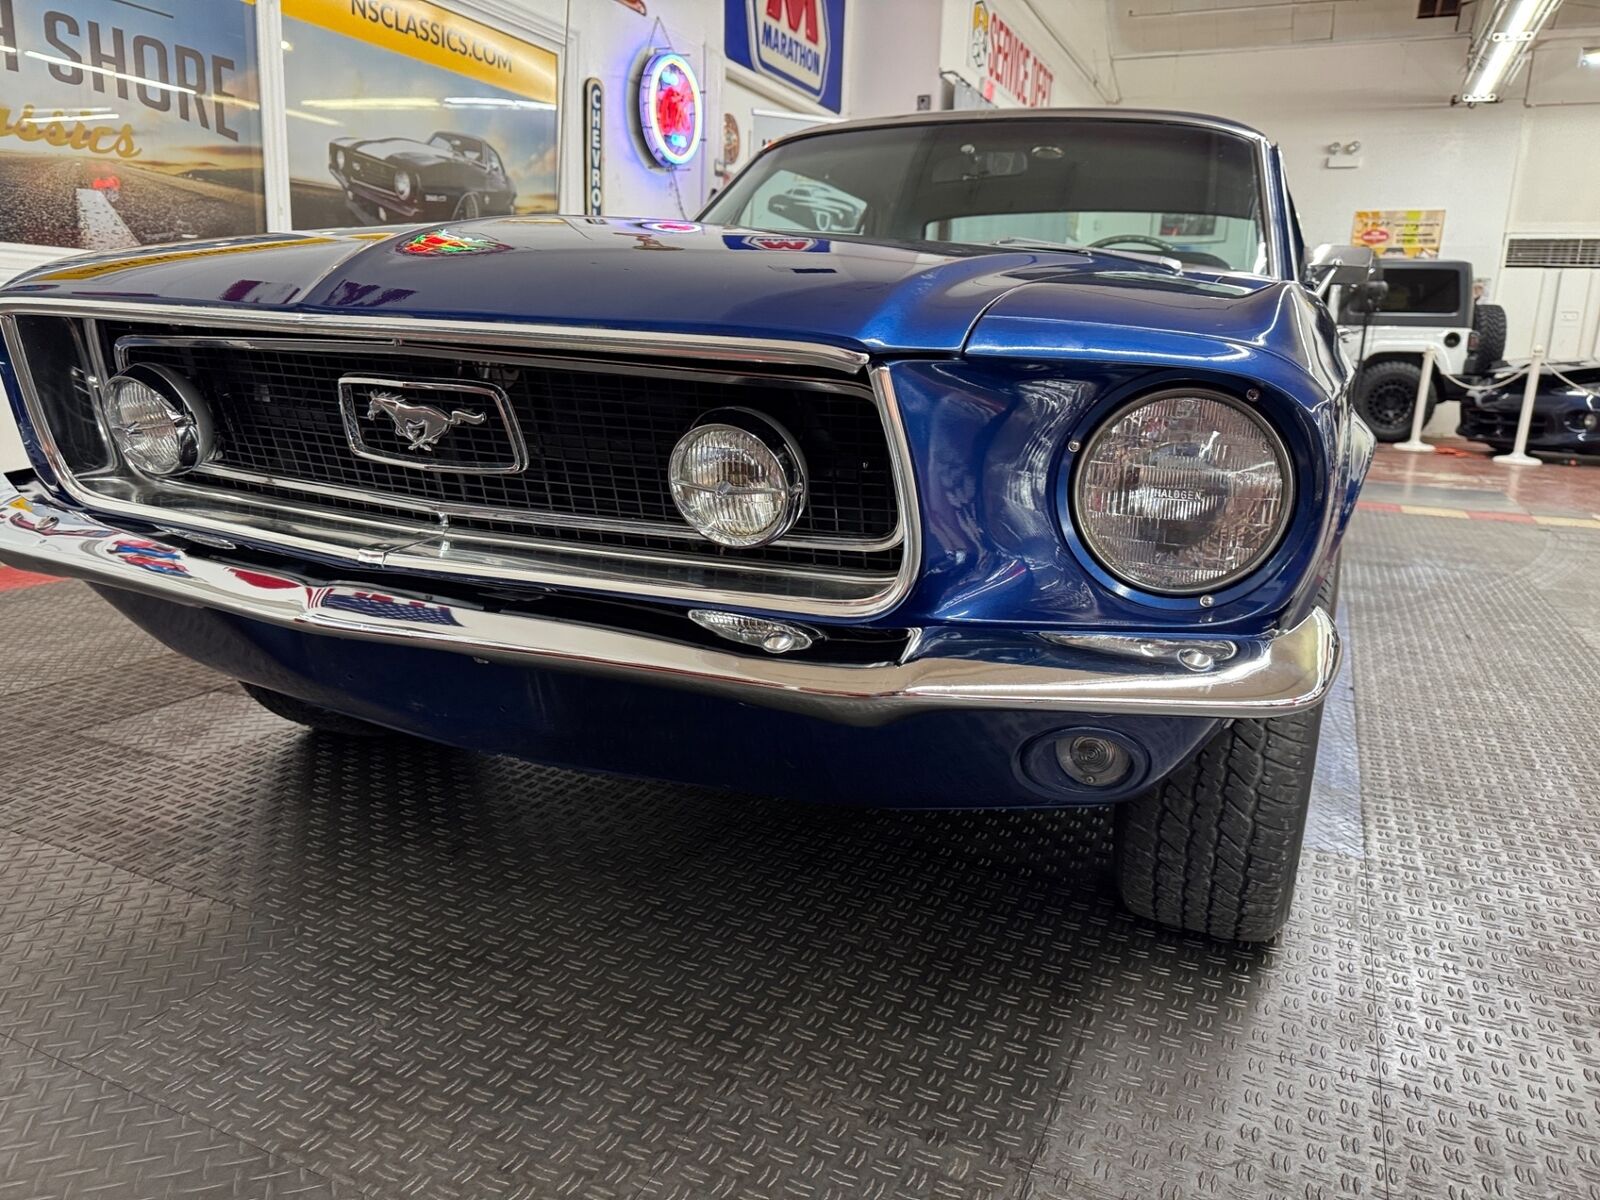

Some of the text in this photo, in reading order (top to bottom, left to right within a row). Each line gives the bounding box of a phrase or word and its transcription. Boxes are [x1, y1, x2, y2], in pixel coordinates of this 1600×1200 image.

[351, 0, 513, 73] NSCLASSICS.COM
[761, 21, 820, 76] MARATHON
[988, 12, 1030, 106] SERVICE
[43, 11, 239, 142] SHORE
[1154, 488, 1201, 500] HALOGEN
